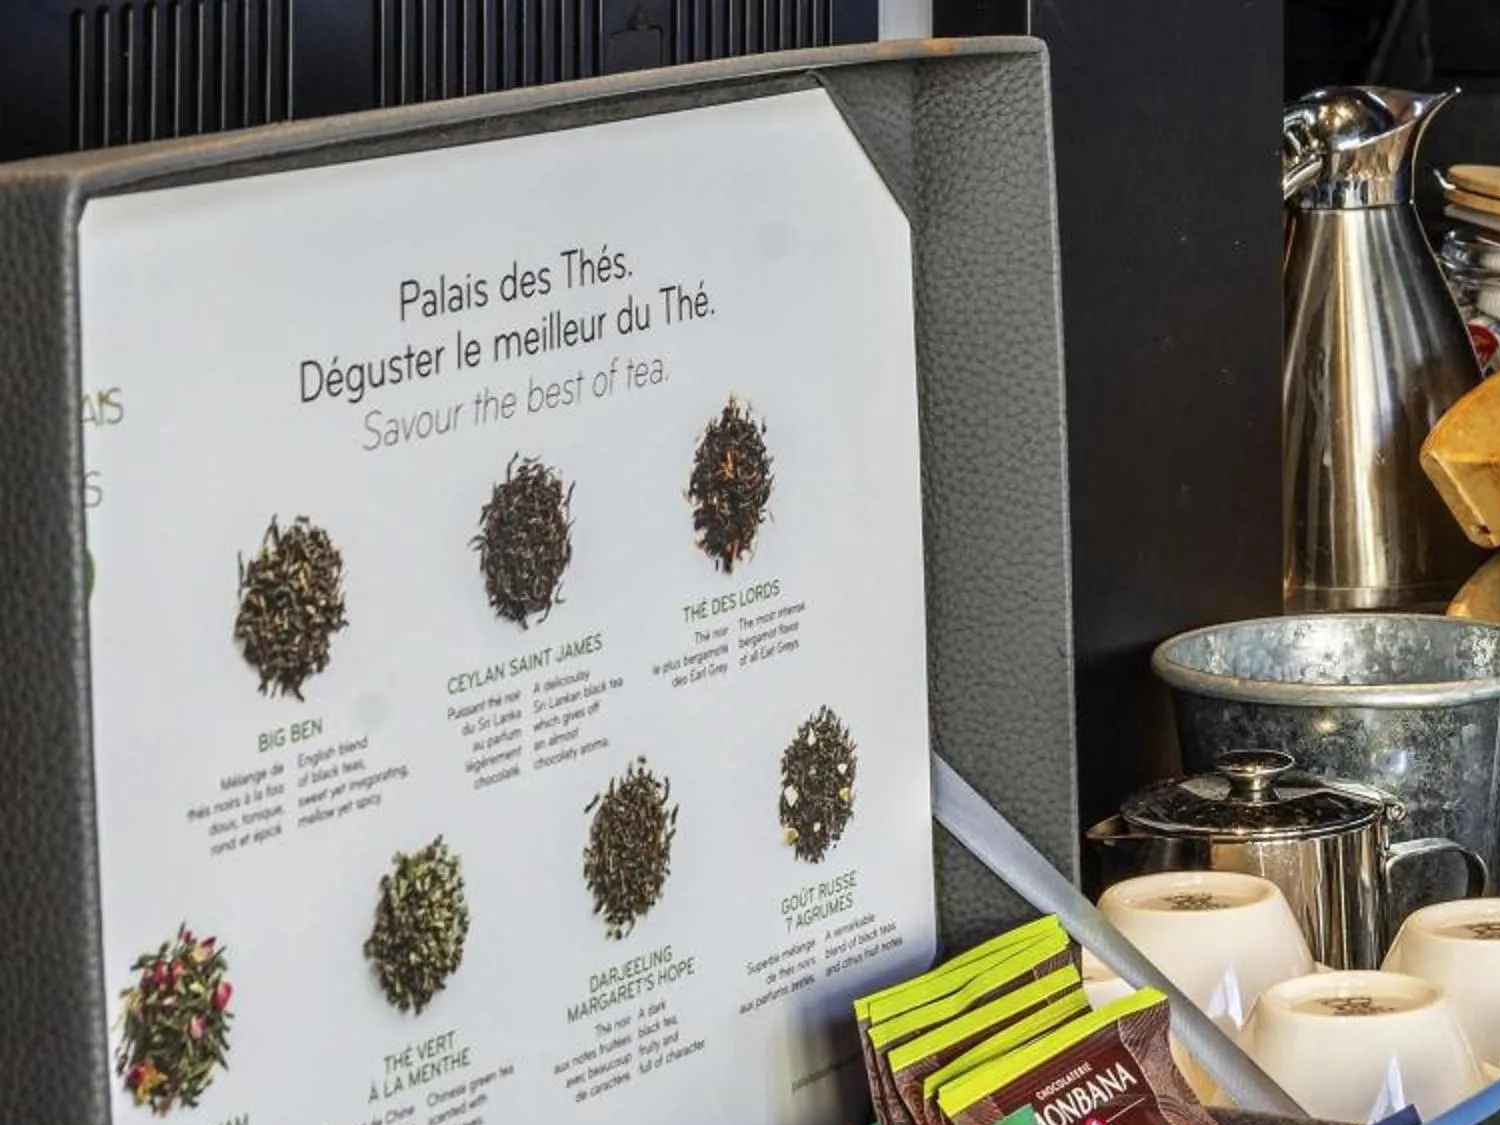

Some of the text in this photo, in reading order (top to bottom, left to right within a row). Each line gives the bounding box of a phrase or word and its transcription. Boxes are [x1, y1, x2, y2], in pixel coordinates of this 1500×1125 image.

[399, 243, 633, 321] Palais des Thés.
[299, 281, 716, 407] Déguster le meilleur du Thé.
[362, 354, 670, 453] Savour the best of tea.
[711, 592, 737, 616] DES
[740, 578, 781, 607] LORDS
[448, 633, 603, 695] CEYLAN SAINT JAMES
[258, 718, 323, 752] BIG BEN
[819, 869, 857, 898] RUSSE
[796, 892, 853, 929] AGRUMES
[589, 944, 673, 993] DARJEELING
[657, 957, 695, 986] HOPE
[416, 1030, 456, 1060] VERT
[383, 1076, 403, 1099] LA
[408, 1046, 472, 1088] MENTHE
